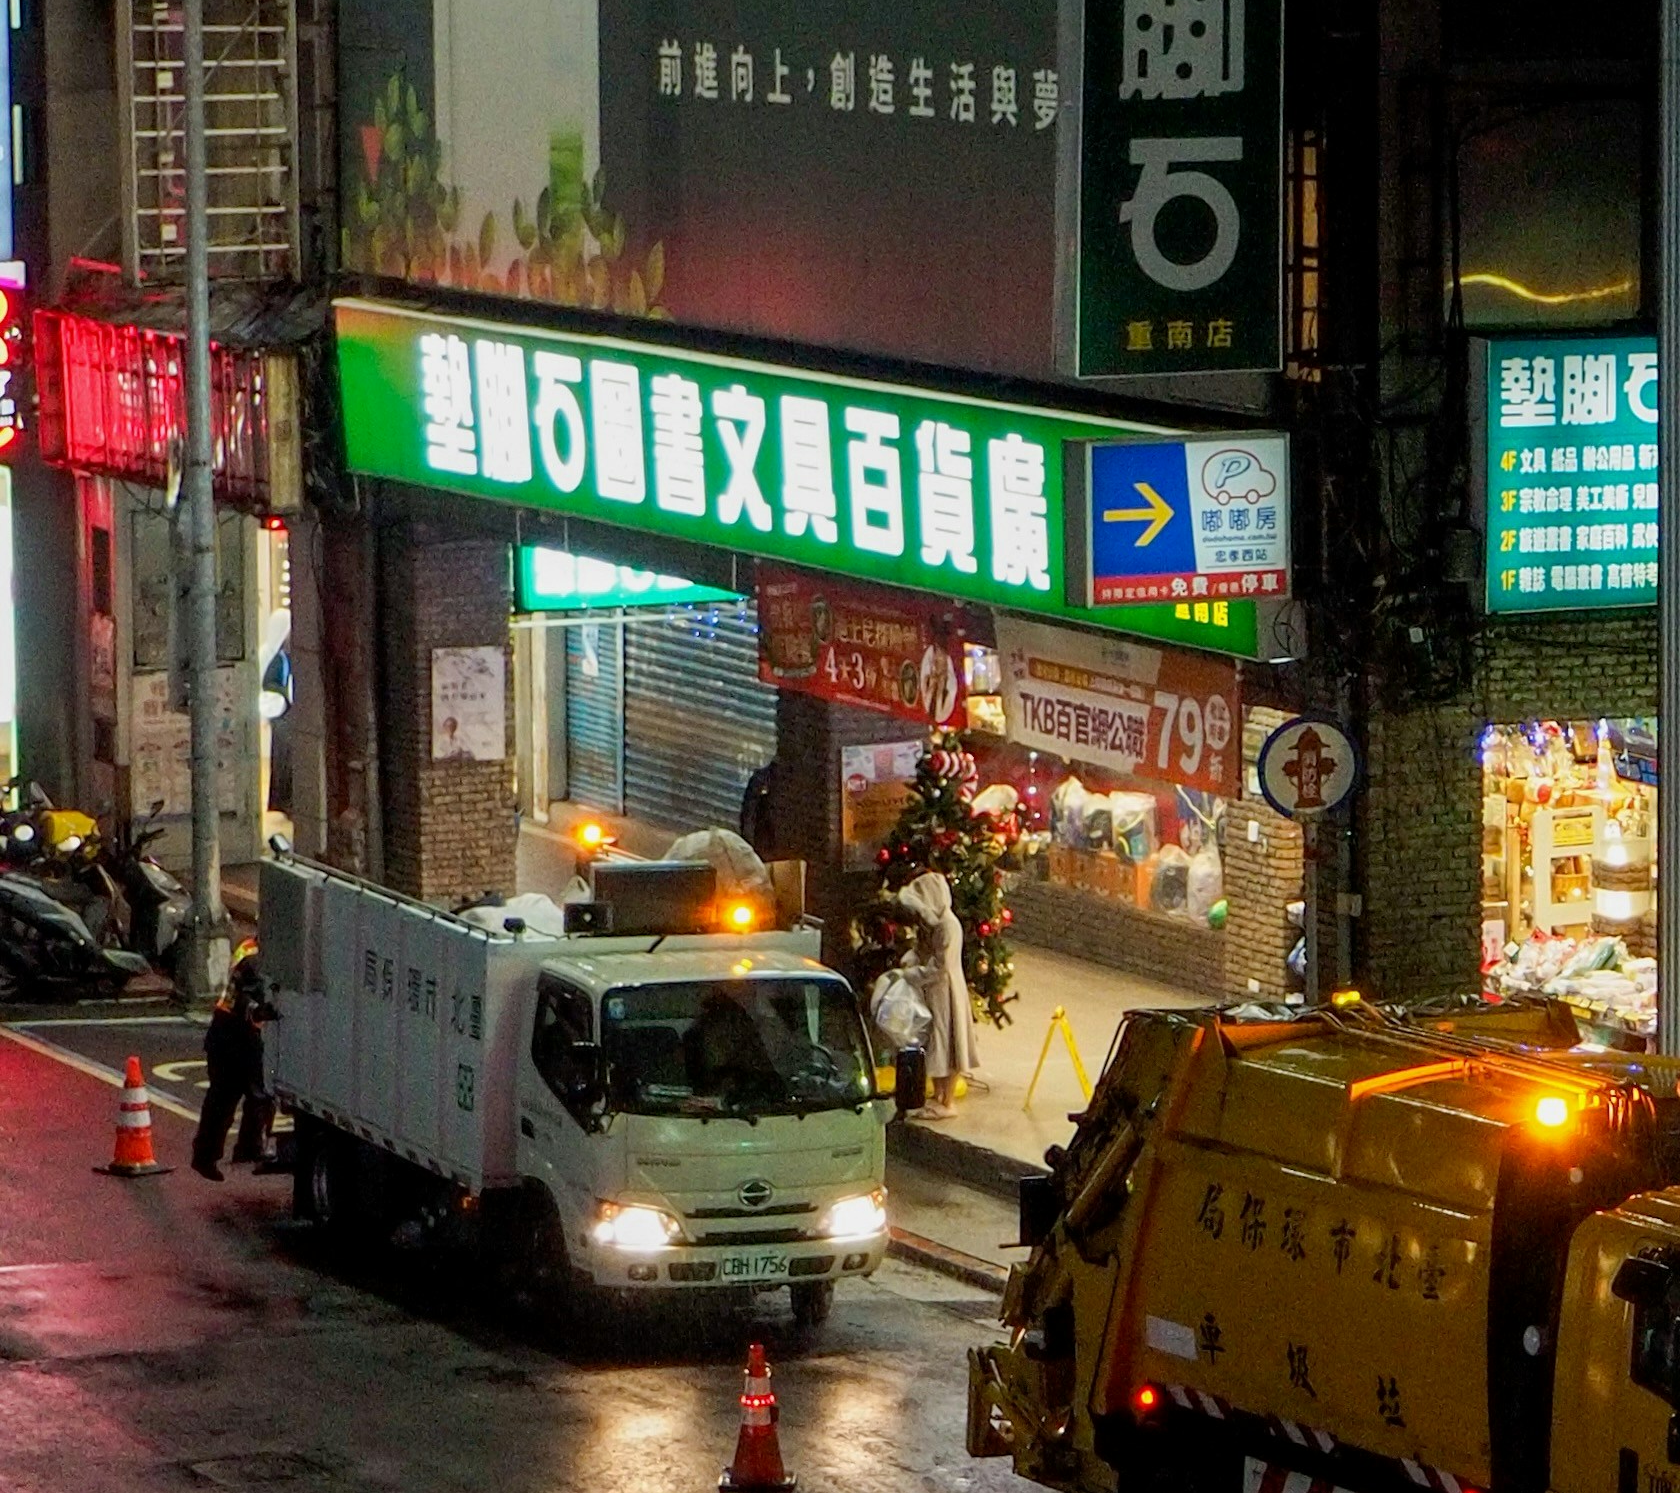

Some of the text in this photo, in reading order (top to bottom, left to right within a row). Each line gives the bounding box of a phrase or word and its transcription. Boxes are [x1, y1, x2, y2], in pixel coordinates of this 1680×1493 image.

[1126, 318, 1234, 350] 重南店
[1501, 450, 1517, 471] 4F
[1501, 490, 1517, 512] 3F
[1202, 506, 1277, 532] 嘟嘟房
[1501, 530, 1516, 552] 2F
